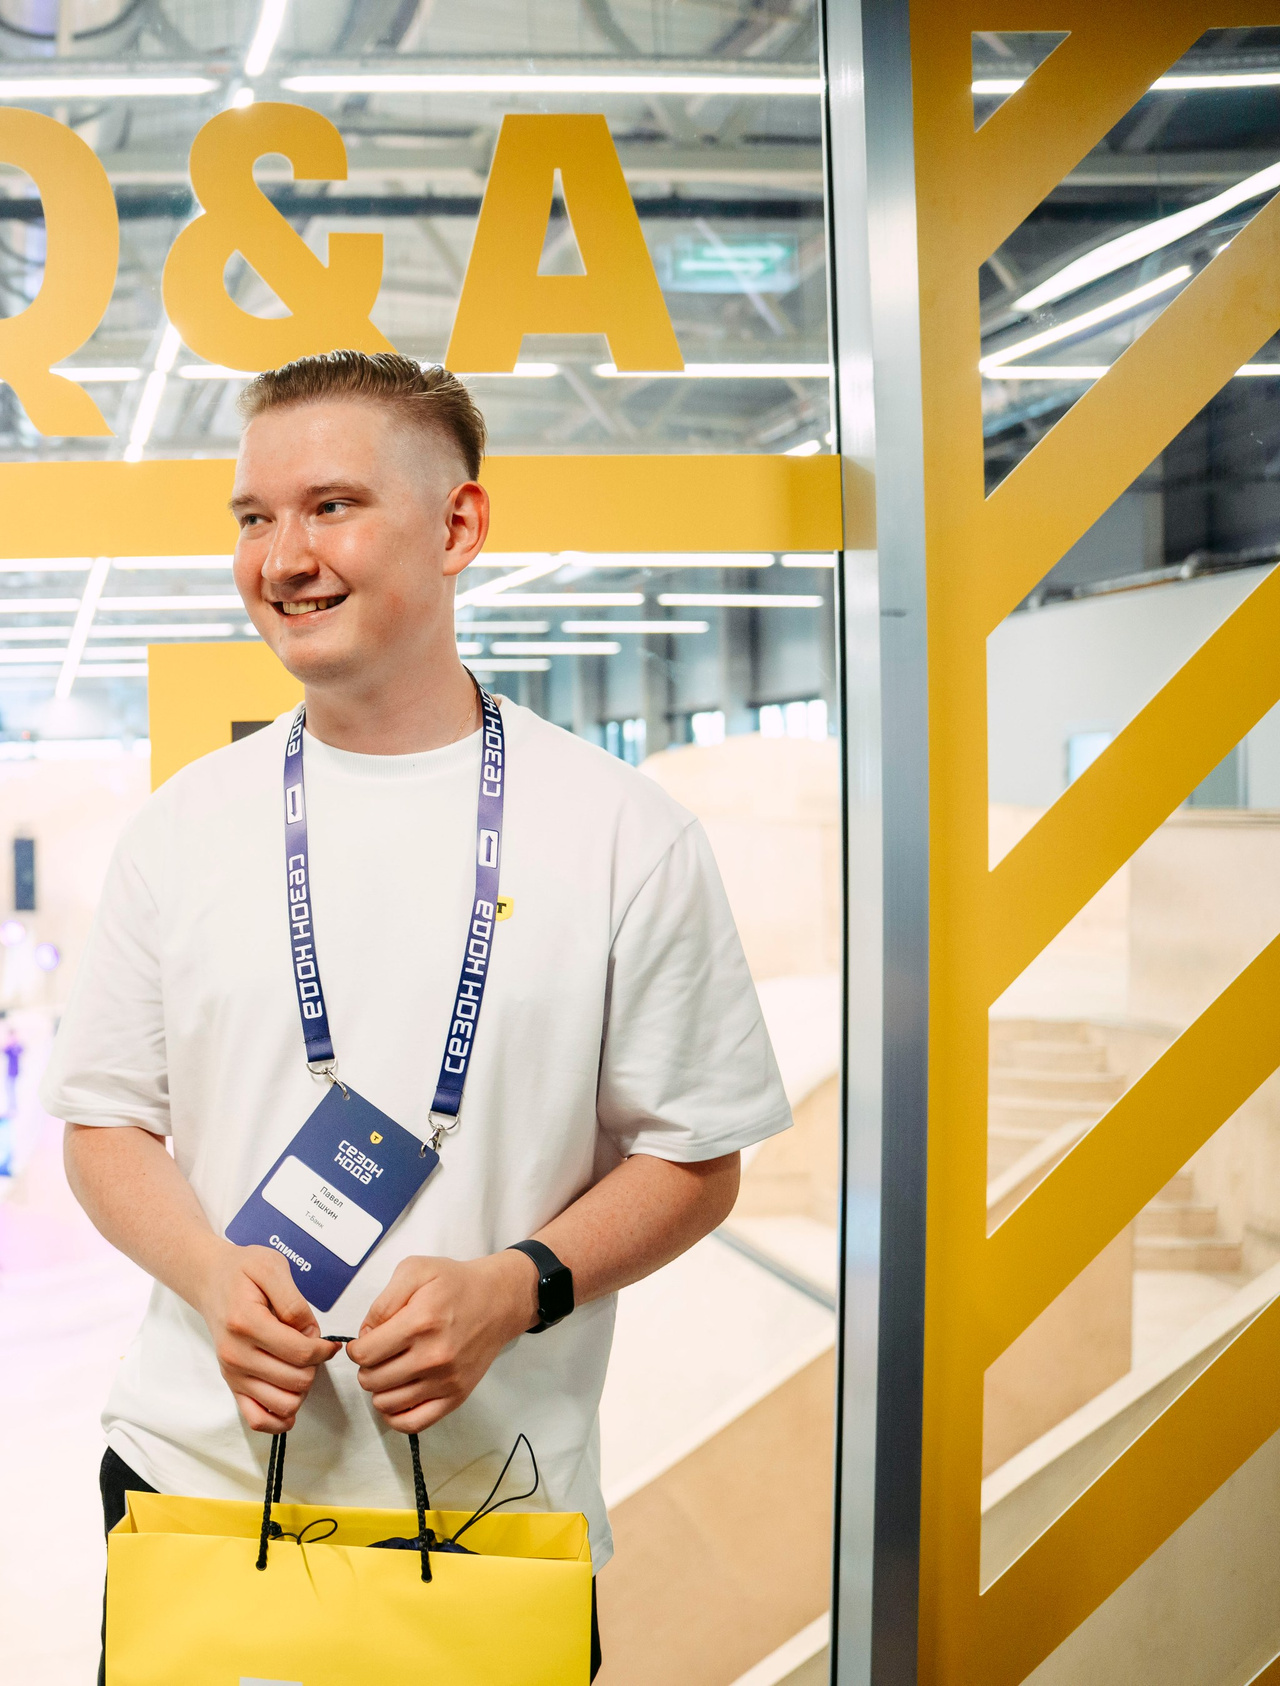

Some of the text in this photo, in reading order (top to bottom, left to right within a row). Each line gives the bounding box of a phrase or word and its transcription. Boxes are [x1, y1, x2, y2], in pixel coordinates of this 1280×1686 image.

[309, 1193, 339, 1220] Тишкин
[319, 1186, 344, 1208] Павел
[269, 1234, 312, 1272] Спикер
